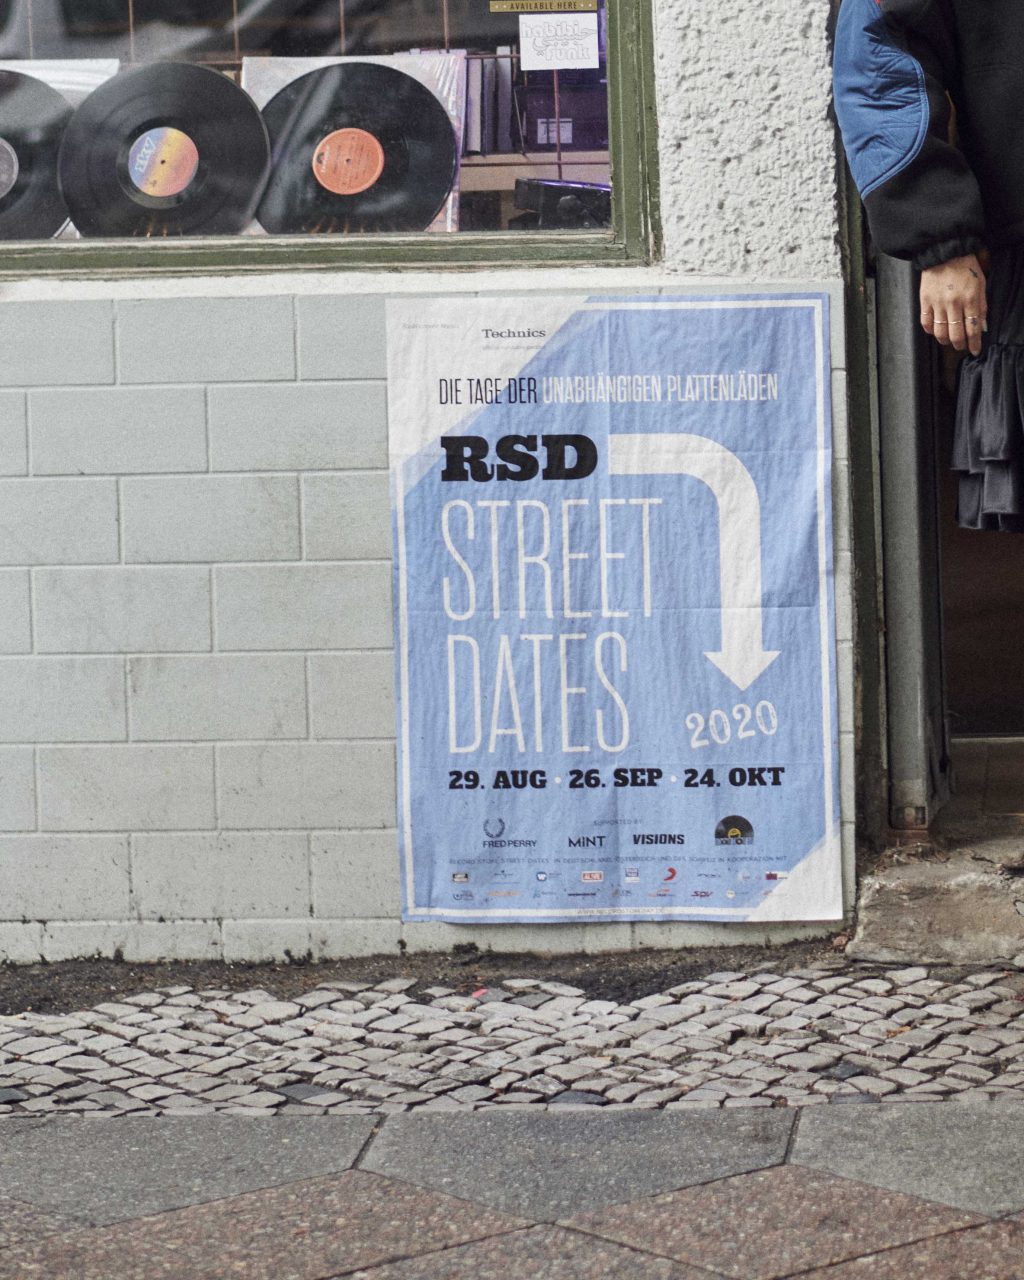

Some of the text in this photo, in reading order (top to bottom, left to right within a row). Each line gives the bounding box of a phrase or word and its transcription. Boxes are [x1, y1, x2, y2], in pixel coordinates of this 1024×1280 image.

[509, 1, 577, 10] AVAILABLE HERE
[482, 328, 546, 339] Technics
[439, 371, 778, 404] DIE TAGE DER UNABHÄNGIGEN PLATTENLÄDEN
[441, 434, 599, 482] RSD
[441, 498, 663, 620] STREET
[447, 631, 630, 754] DATES
[685, 699, 779, 749] 2020
[449, 767, 785, 790] 29. AUG 26. SEP 24. OKT
[483, 839, 537, 848] FRED PERRY
[633, 834, 685, 845] VISIONS
